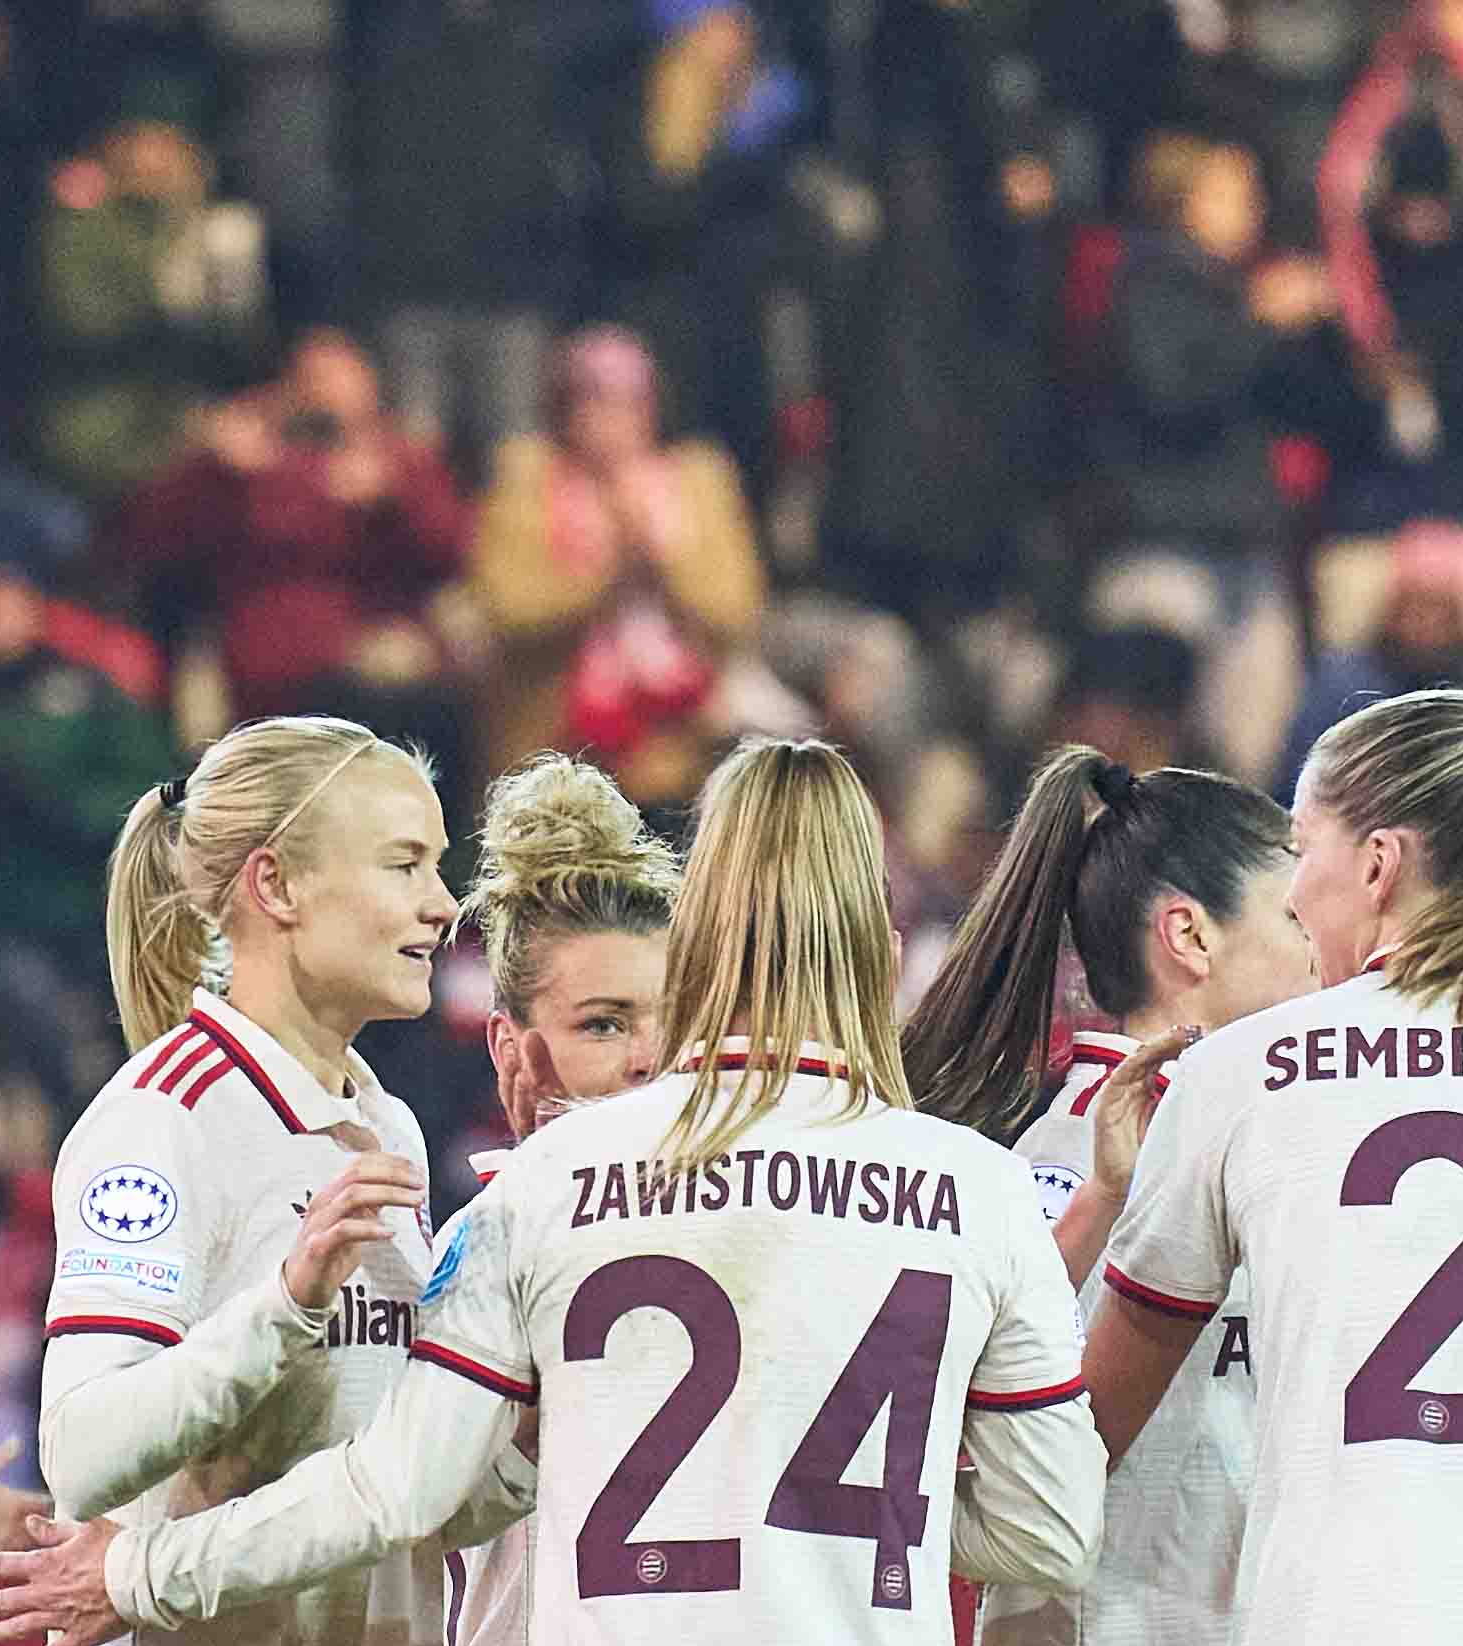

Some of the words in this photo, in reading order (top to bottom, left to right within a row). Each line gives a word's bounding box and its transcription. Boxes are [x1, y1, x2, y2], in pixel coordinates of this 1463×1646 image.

[571, 1149, 961, 1236] ZAWISTOWSKA
[60, 1255, 179, 1283] FOUNDATION
[563, 1253, 952, 1610] 24
